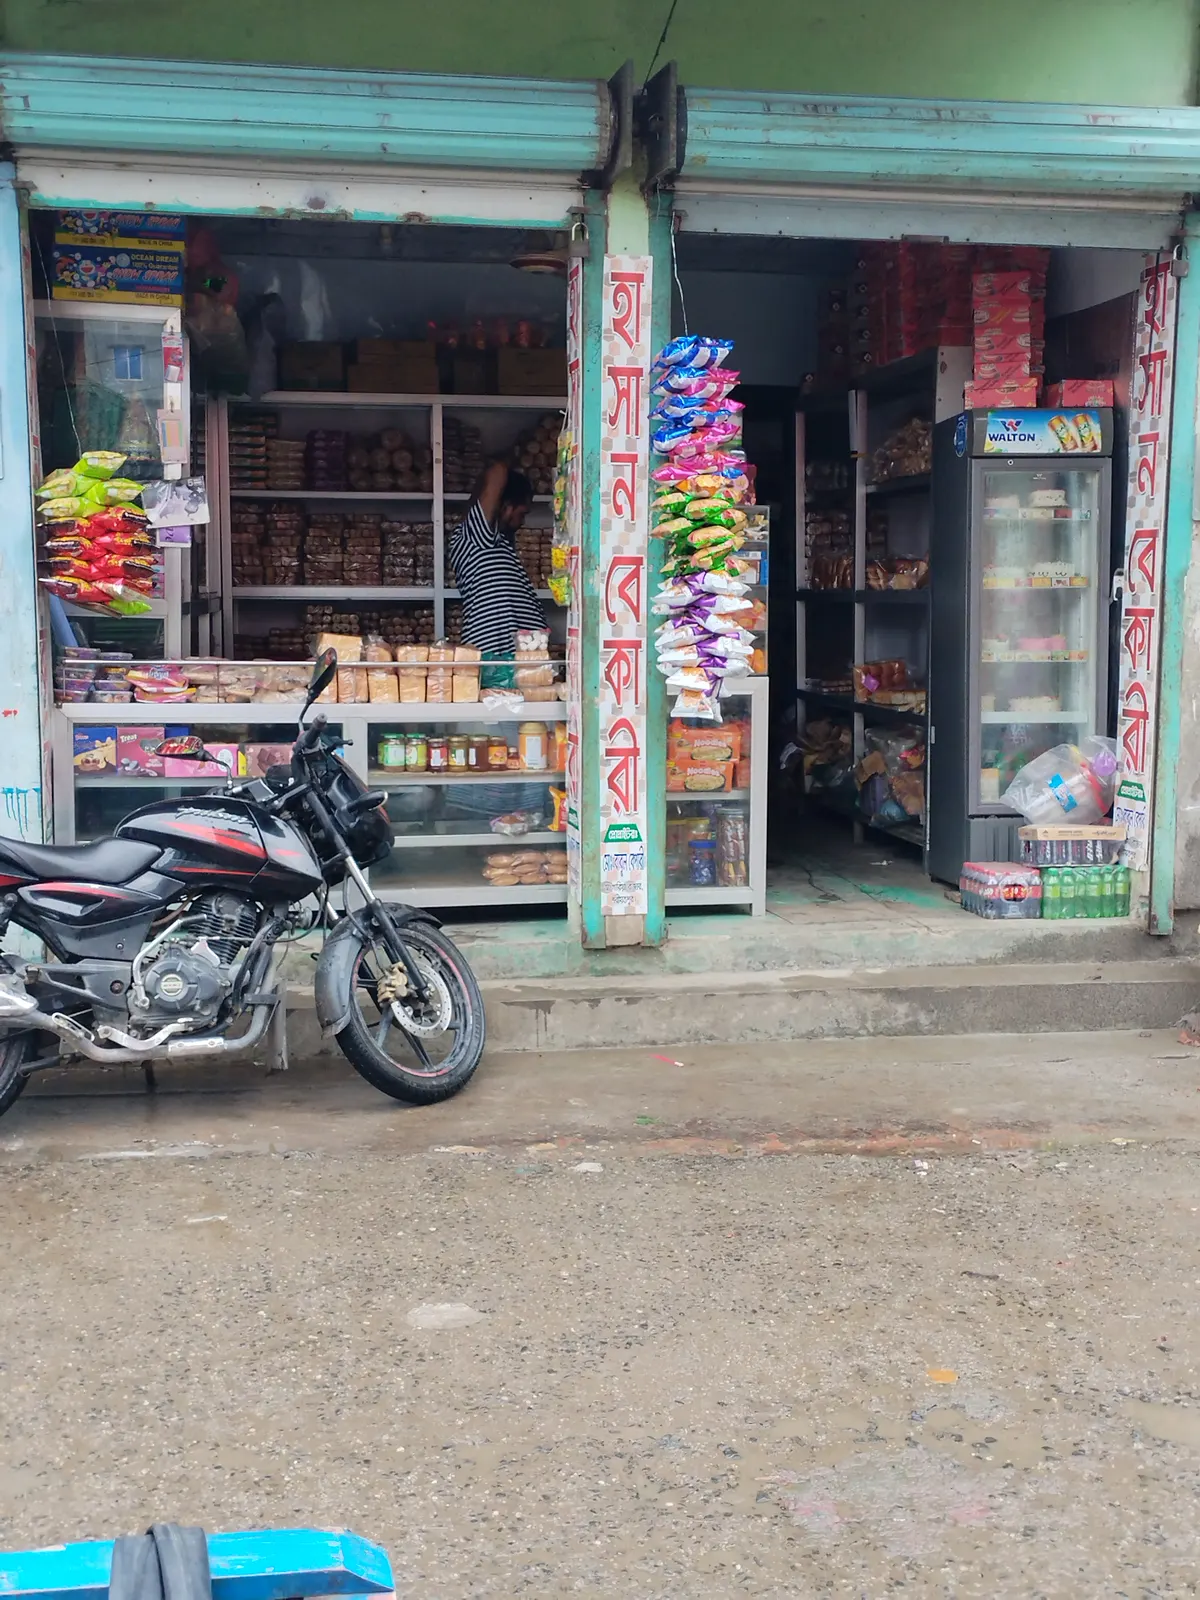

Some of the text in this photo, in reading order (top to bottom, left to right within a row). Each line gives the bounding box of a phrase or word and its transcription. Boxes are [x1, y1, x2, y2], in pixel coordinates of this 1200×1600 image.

[988, 433, 1036, 442] WALTON
[120, 733, 138, 743] Treat
[693, 739, 728, 748] Noodles
[687, 766, 721, 777] Noodles
